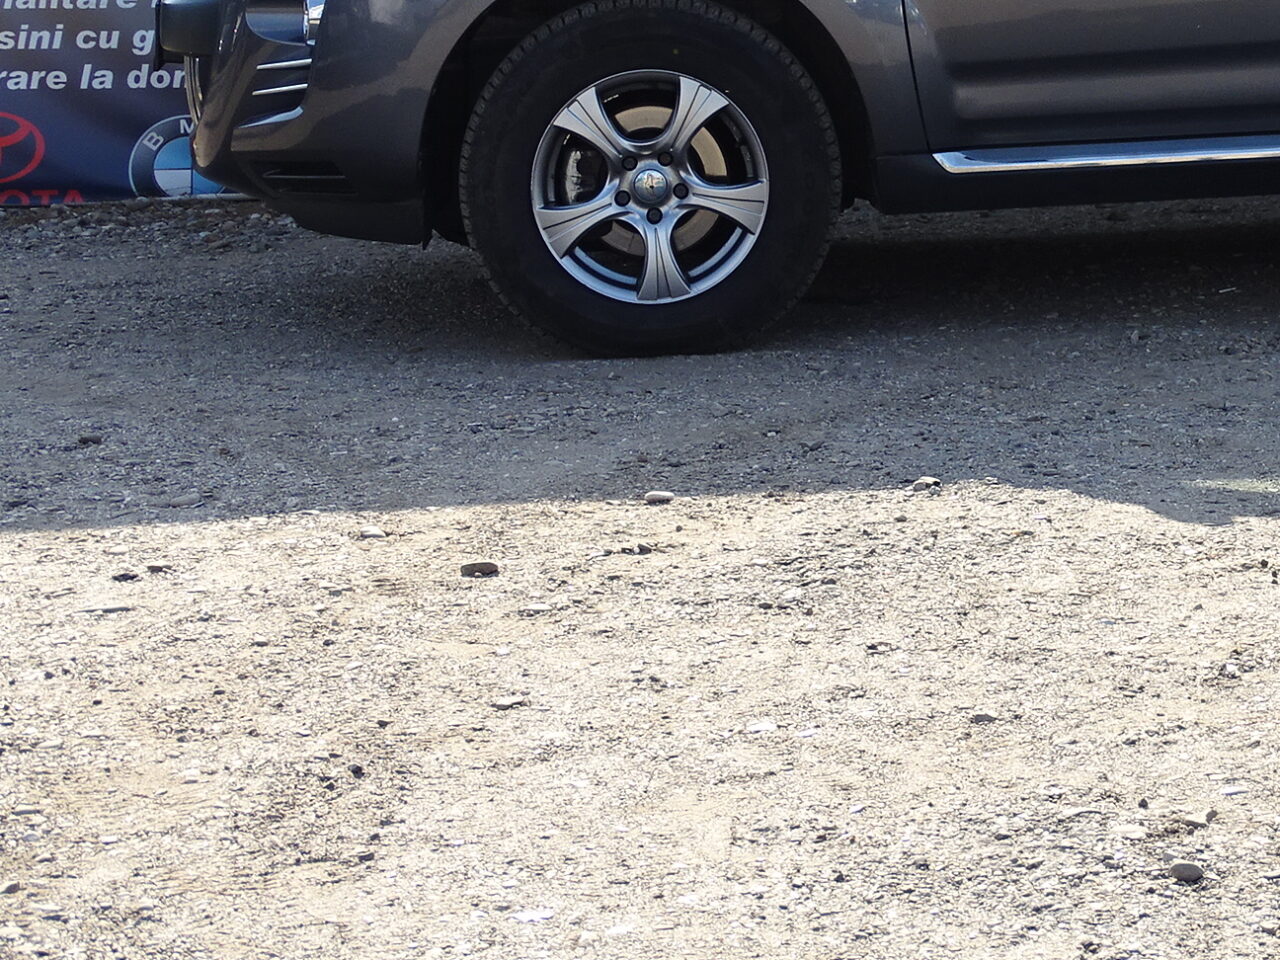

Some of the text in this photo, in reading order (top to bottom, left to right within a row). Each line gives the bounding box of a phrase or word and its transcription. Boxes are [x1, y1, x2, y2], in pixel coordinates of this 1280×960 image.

[0, 24, 64, 49] sini
[75, 29, 120, 49] cu
[80, 63, 114, 89] la
